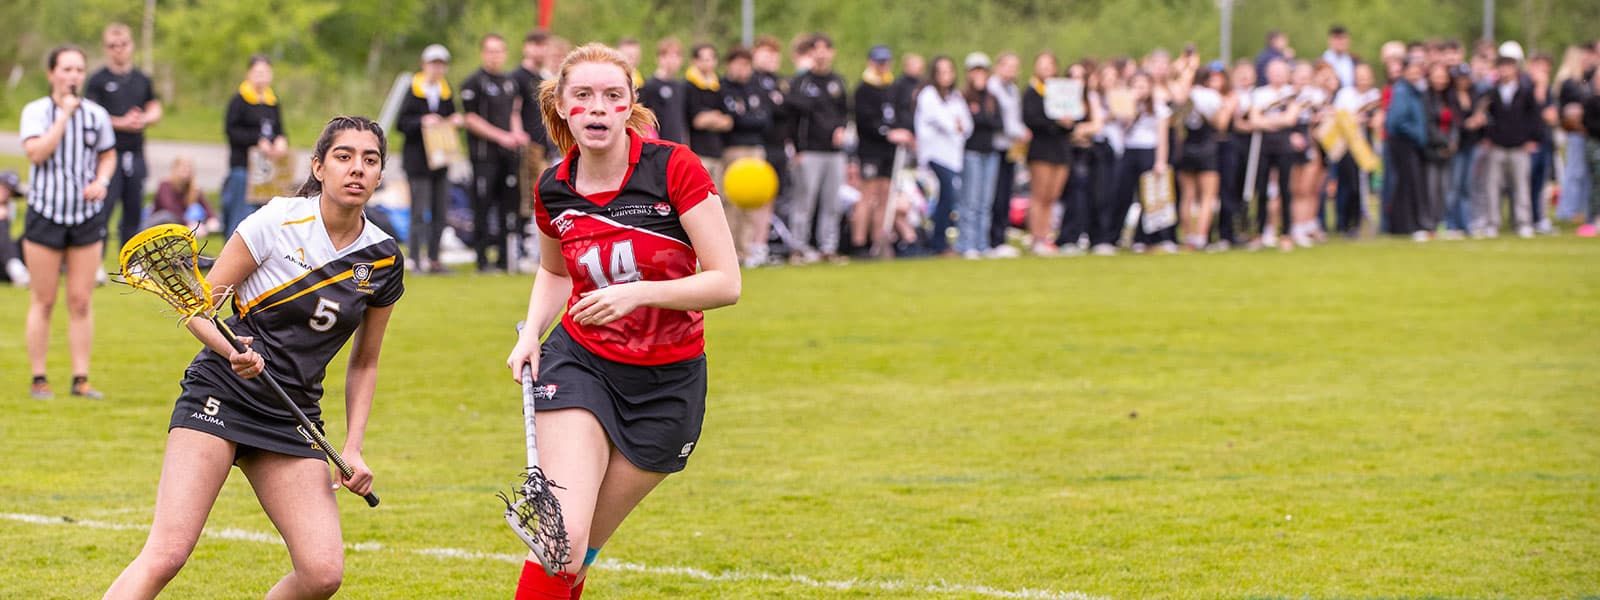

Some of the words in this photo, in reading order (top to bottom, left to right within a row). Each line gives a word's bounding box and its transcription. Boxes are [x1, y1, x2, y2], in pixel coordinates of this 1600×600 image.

[610, 207, 652, 218] University
[283, 254, 313, 271] AKMA
[577, 239, 643, 289] 14
[309, 296, 341, 332] 5
[203, 396, 221, 416] 5
[190, 411, 226, 429] AKUMA
